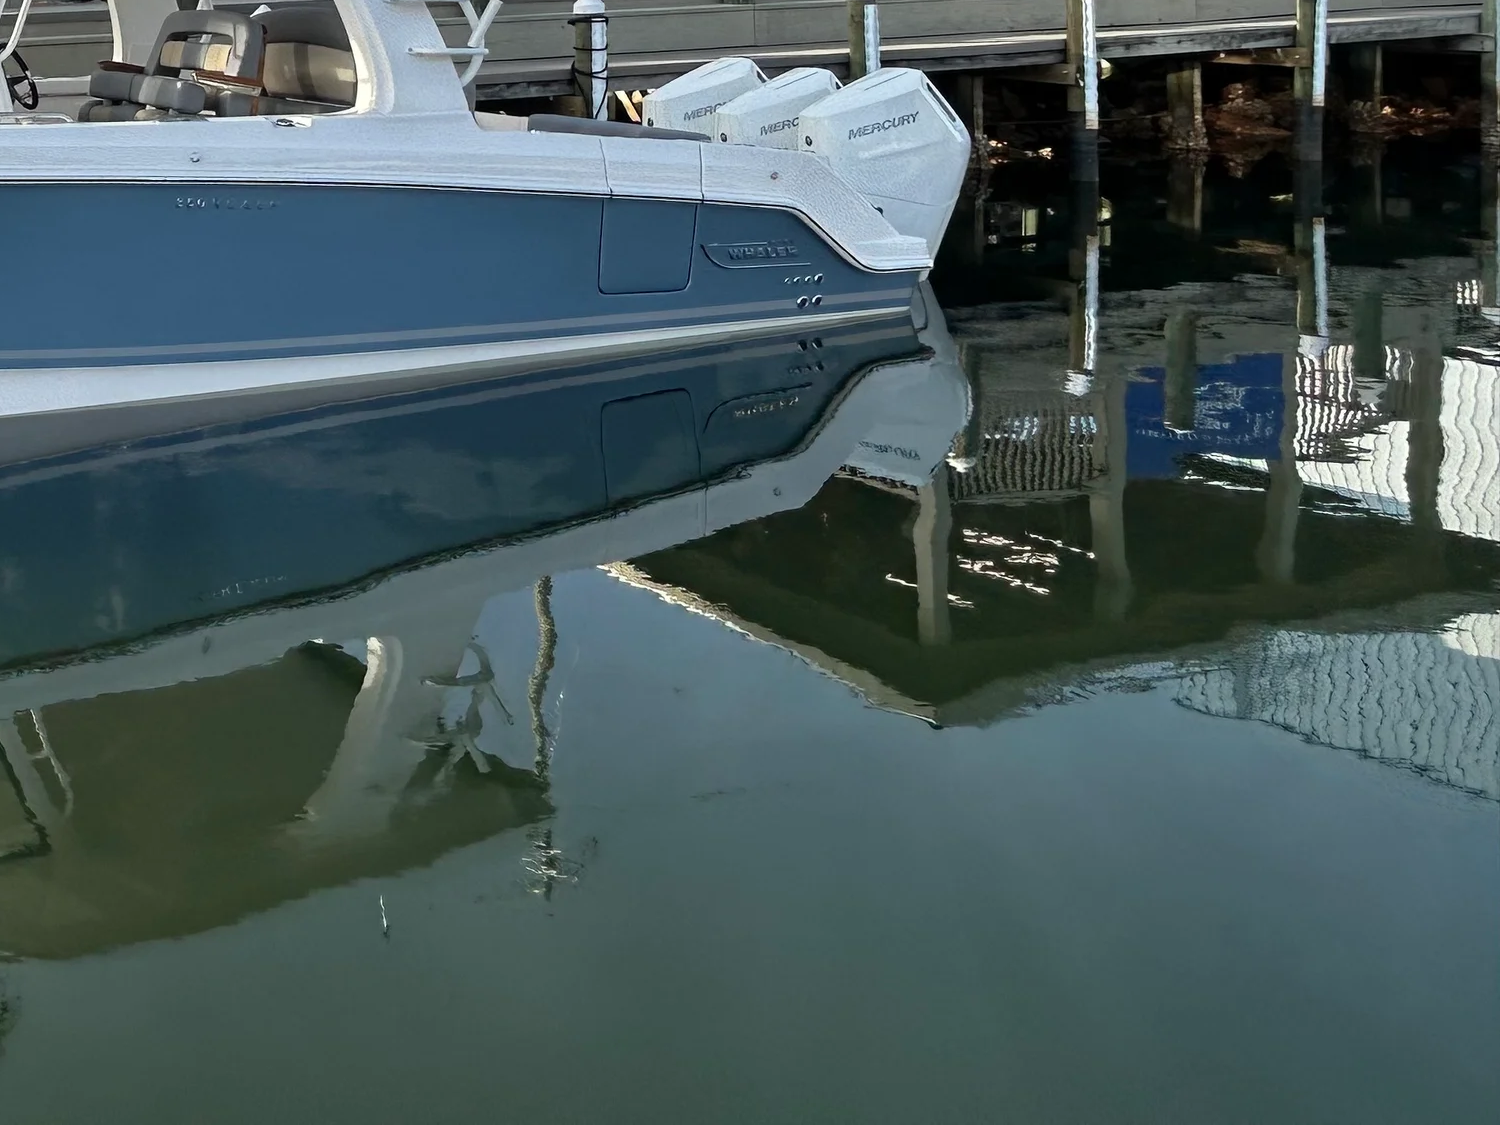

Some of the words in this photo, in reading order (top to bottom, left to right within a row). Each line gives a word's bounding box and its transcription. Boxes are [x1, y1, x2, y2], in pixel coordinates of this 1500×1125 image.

[683, 101, 727, 121] MERC
[760, 116, 800, 136] MERC
[847, 111, 920, 141] MERCURY
